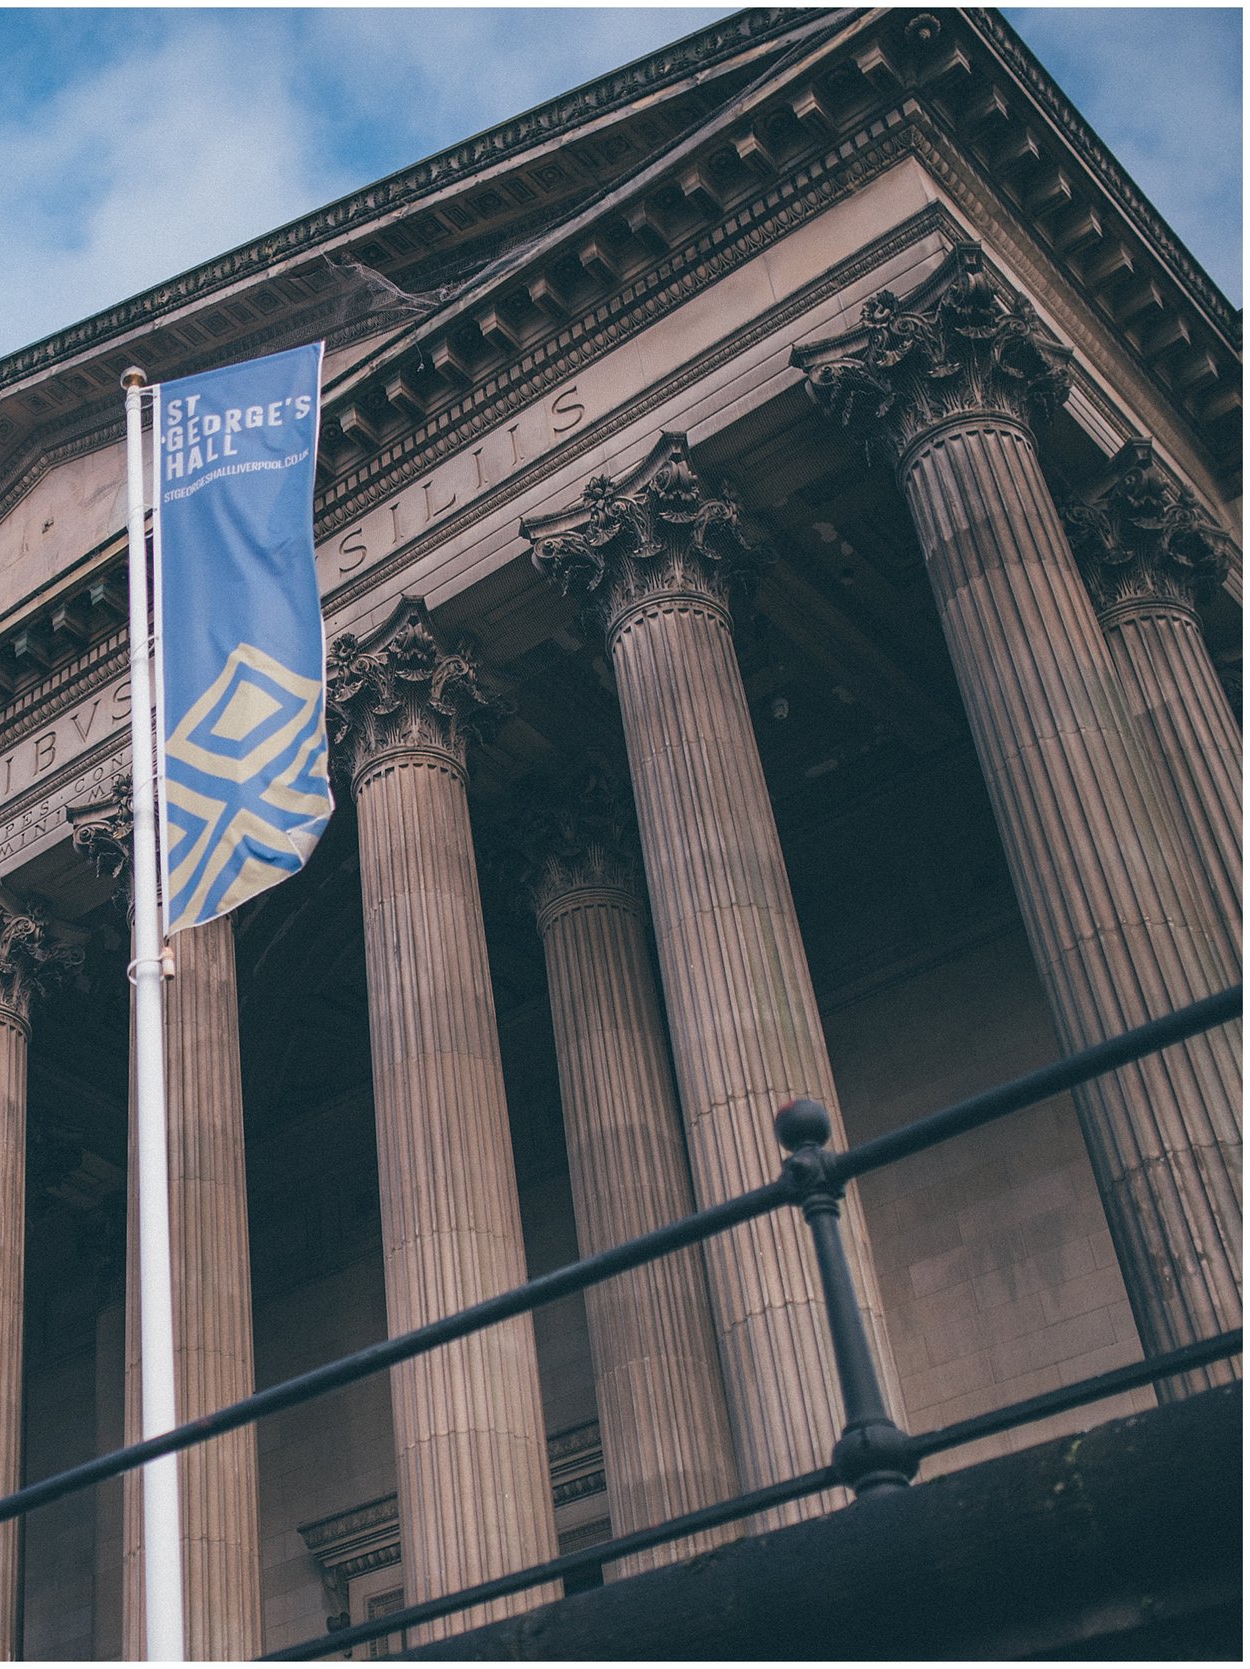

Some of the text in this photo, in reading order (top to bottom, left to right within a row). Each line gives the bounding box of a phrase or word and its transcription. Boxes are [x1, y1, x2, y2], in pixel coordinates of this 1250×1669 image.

[165, 395, 312, 452] GEORGE'S
[167, 394, 201, 426] ST
[165, 433, 238, 481] HALL
[315, 386, 585, 577] SILIIS
